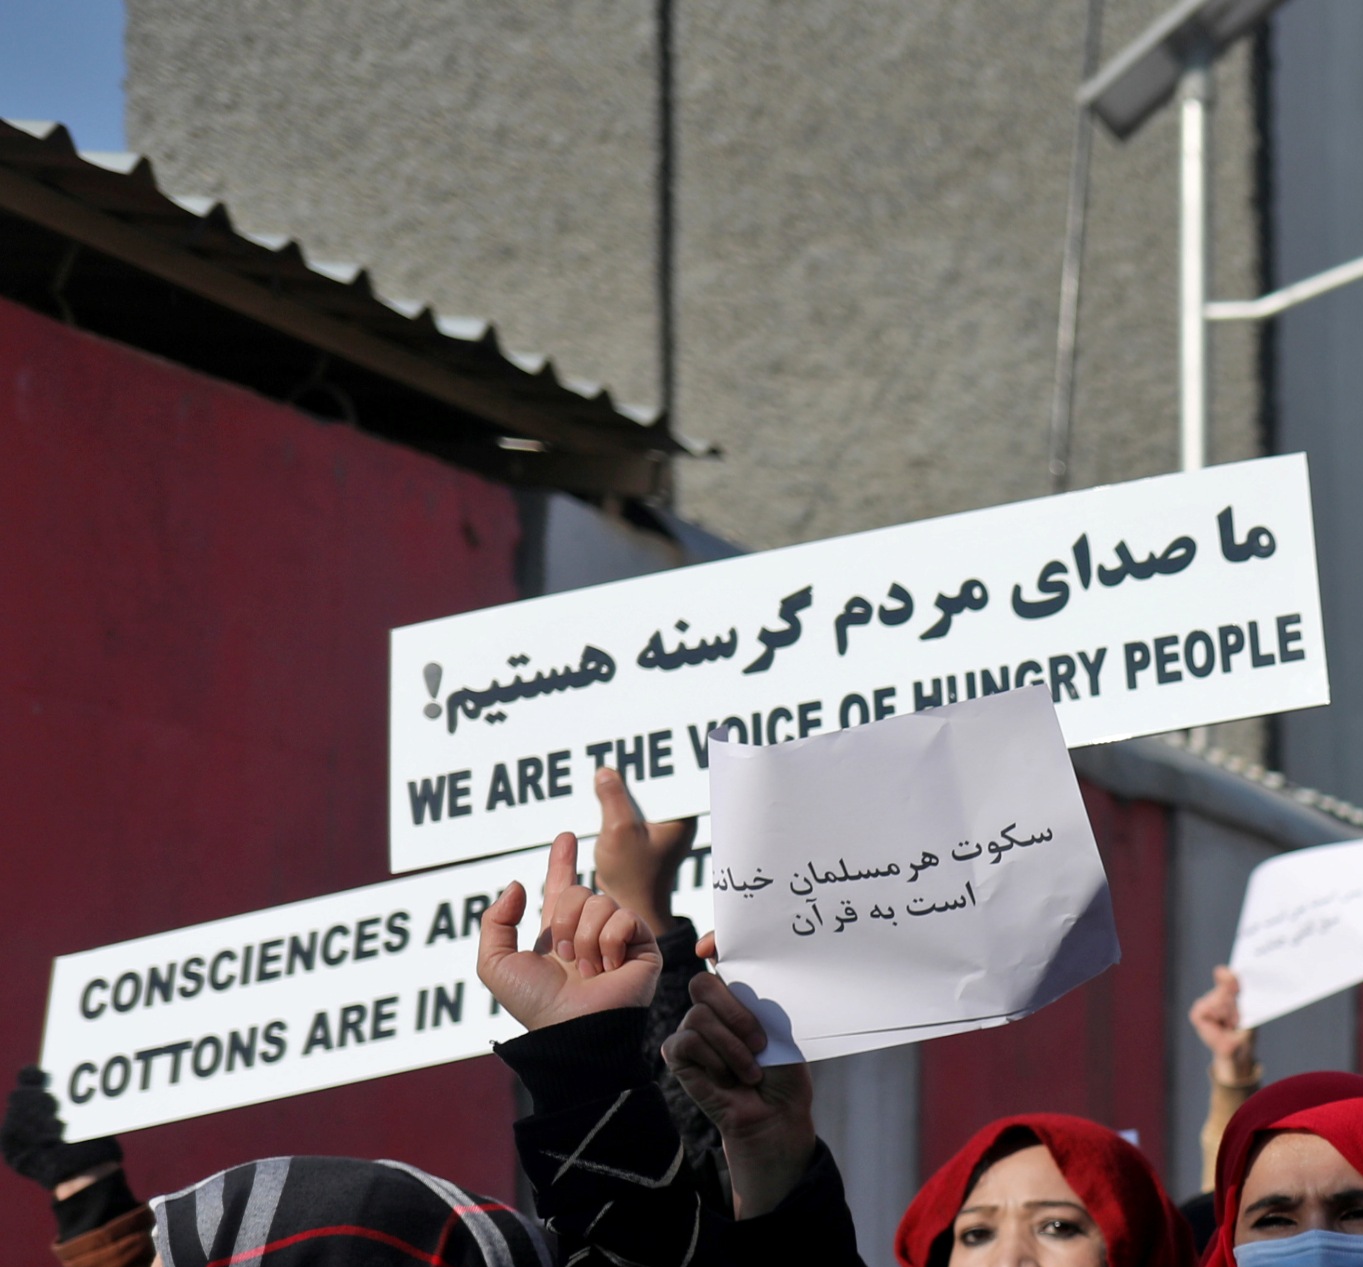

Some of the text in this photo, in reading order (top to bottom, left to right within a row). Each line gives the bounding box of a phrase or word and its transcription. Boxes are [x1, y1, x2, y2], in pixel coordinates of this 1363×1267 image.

[1219, 504, 1277, 563] ما
[1010, 533, 1196, 620] صدای
[637, 586, 812, 674] گرسنه
[834, 578, 989, 653] مردم
[409, 771, 471, 827] WE
[487, 753, 573, 813] ARE
[590, 730, 673, 787] THE
[840, 687, 896, 731] OF
[1126, 614, 1305, 689] PEOPLE
[788, 858, 901, 896] مسلمان
[905, 851, 940, 882] هر
[950, 822, 1053, 864] سکوت
[792, 881, 976, 937] است به قرآن
[81, 889, 502, 1021] CONSCIENCES AR
[68, 1020, 286, 1104] COTTONS
[303, 996, 397, 1055] ARE
[415, 982, 464, 1032] IN
